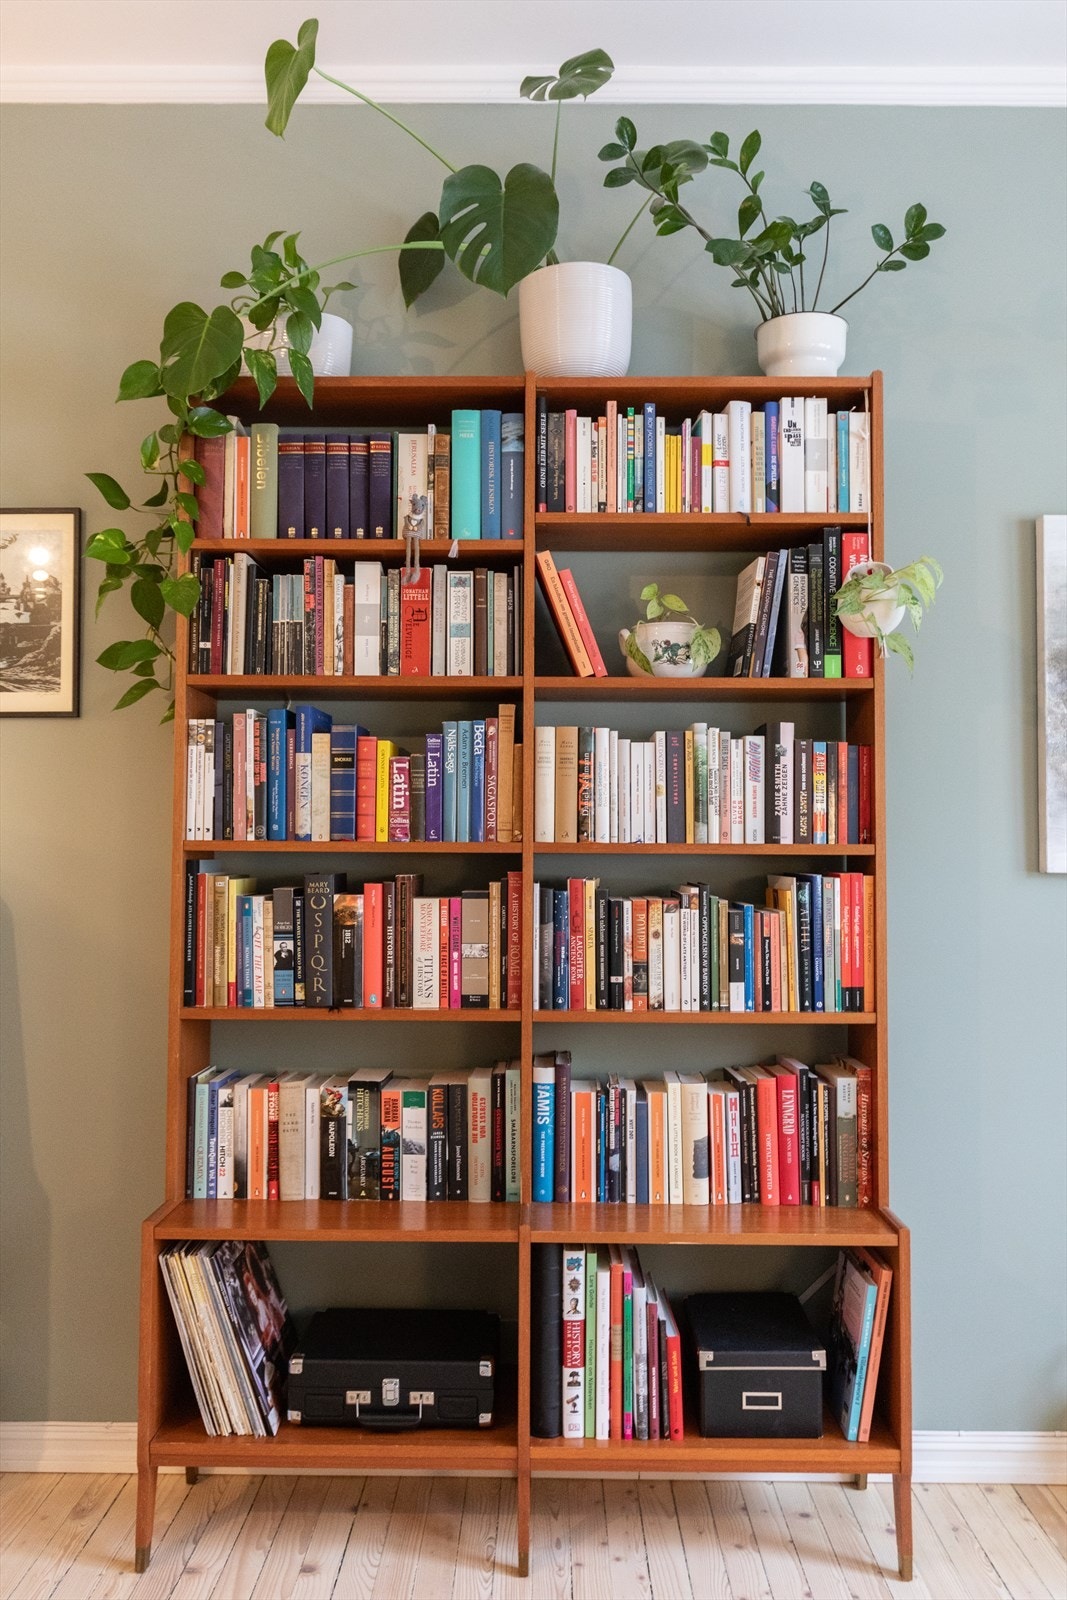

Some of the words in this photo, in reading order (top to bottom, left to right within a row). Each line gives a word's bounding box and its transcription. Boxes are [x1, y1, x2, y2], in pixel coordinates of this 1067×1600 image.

[257, 434, 269, 489] Bibelen
[763, 580, 773, 612] DEVELOPING
[746, 624, 754, 657] REVOLUTION
[759, 614, 768, 636] GENOME
[446, 729, 456, 751] Njåls
[462, 751, 468, 759] av
[473, 725, 484, 755] Beda
[428, 752, 440, 787] Latin
[445, 753, 454, 773] saga
[748, 741, 761, 783] DANUBIA
[300, 765, 308, 808] KONGEN
[393, 762, 409, 809] Latin
[487, 775, 496, 828] SAGASPOR
[636, 914, 645, 952] POMPEII
[800, 909, 810, 952] ATTILA
[424, 955, 433, 998] TITANS
[511, 944, 519, 976] ROME
[433, 1088, 443, 1128] KOLLAPS
[537, 1090, 549, 1124] AMIS
[782, 1090, 795, 1134] LENINGRAD
[861, 1138, 868, 1148] OF
[220, 1168, 225, 1176] 22
[382, 1147, 393, 1190] AUGUST
[572, 1322, 581, 1366] HISTORY
[588, 1367, 594, 1376] om
